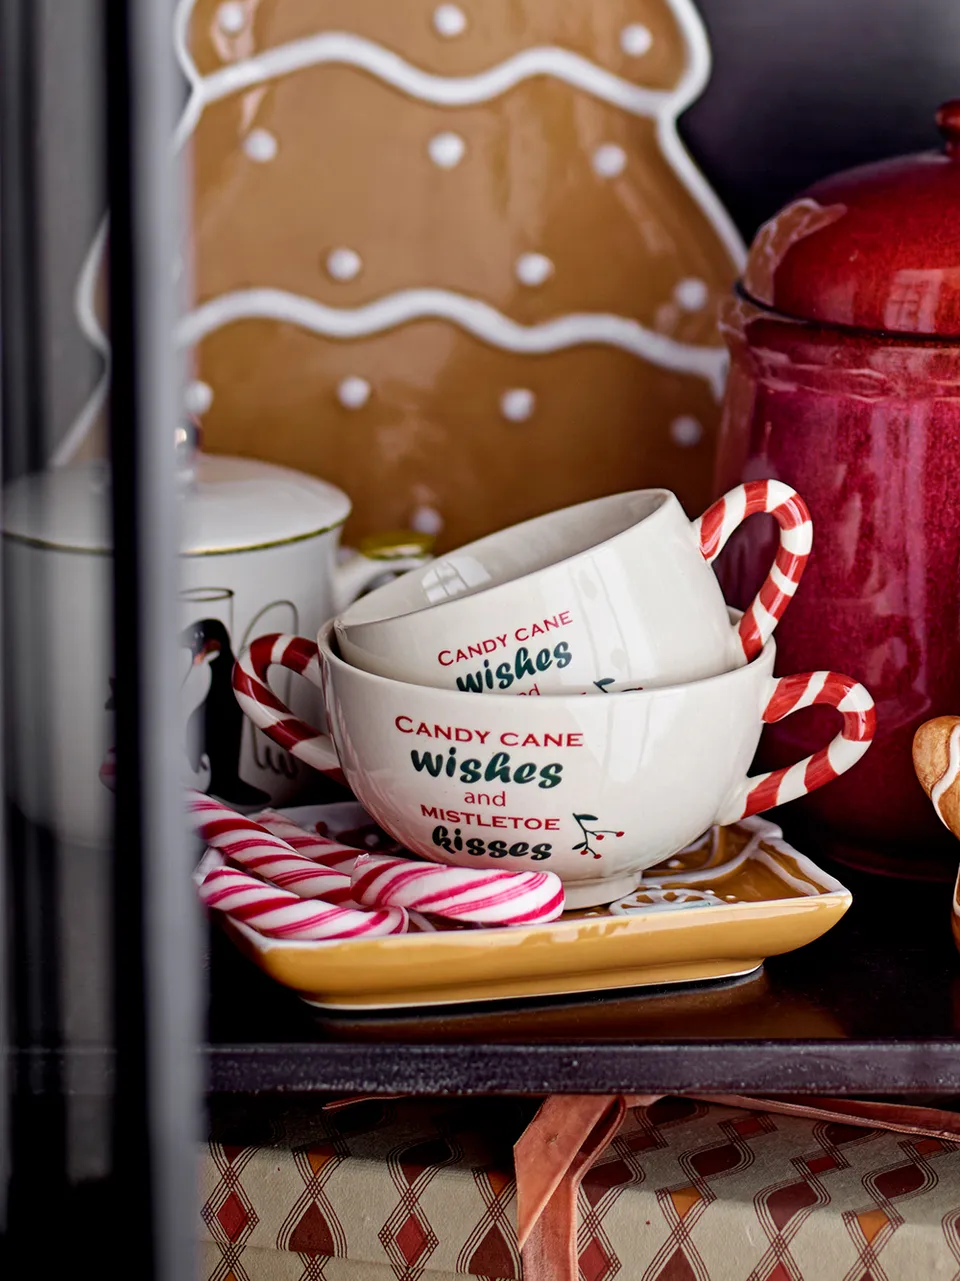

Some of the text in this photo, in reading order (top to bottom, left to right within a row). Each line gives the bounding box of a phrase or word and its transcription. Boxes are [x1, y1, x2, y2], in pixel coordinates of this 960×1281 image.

[438, 610, 574, 667] CANDY CANE
[456, 641, 573, 694] wishes
[394, 715, 584, 748] CANDY CANE
[410, 746, 564, 790] wishes
[464, 790, 507, 807] and
[420, 804, 561, 831] MISTLETOE
[432, 825, 553, 861] kisses
